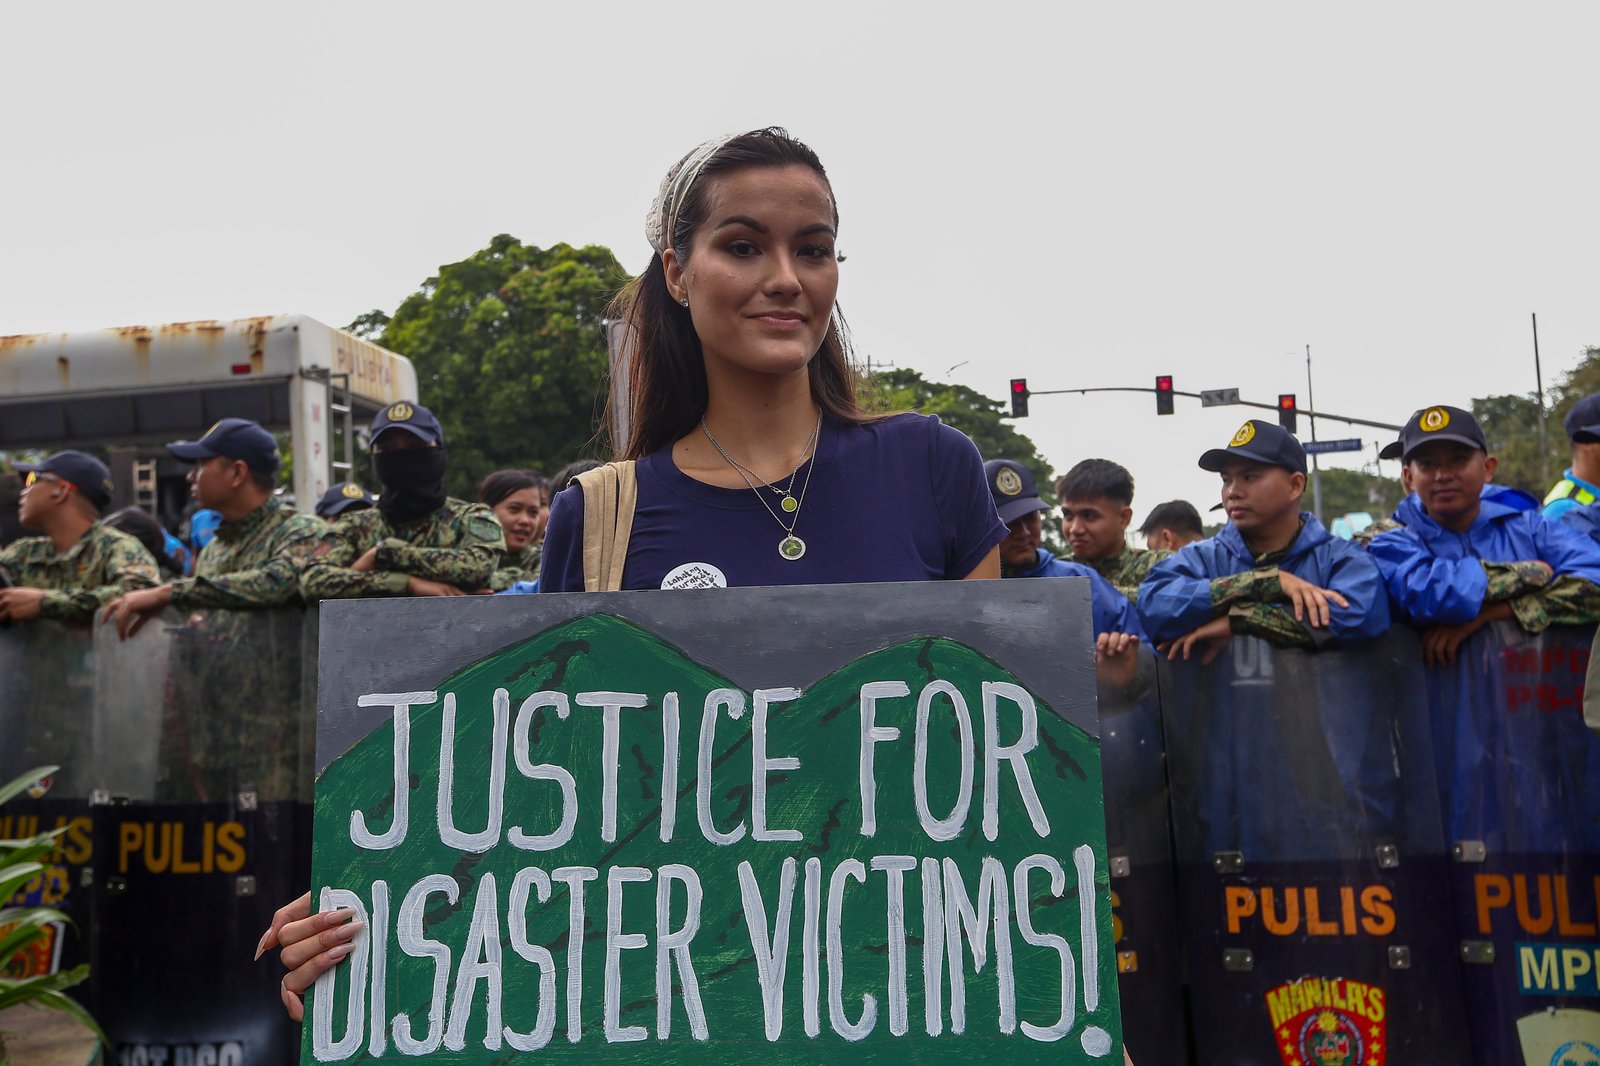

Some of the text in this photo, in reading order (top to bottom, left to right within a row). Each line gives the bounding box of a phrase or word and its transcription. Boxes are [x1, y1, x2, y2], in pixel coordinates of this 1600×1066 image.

[350, 680, 1051, 853] JUSTICE FOR
[118, 821, 246, 874] PULIS
[1225, 885, 1396, 936] PULIS
[312, 844, 1112, 1063] DISASTER VICTIMS!
[1266, 977, 1385, 1030] MANILA'S
